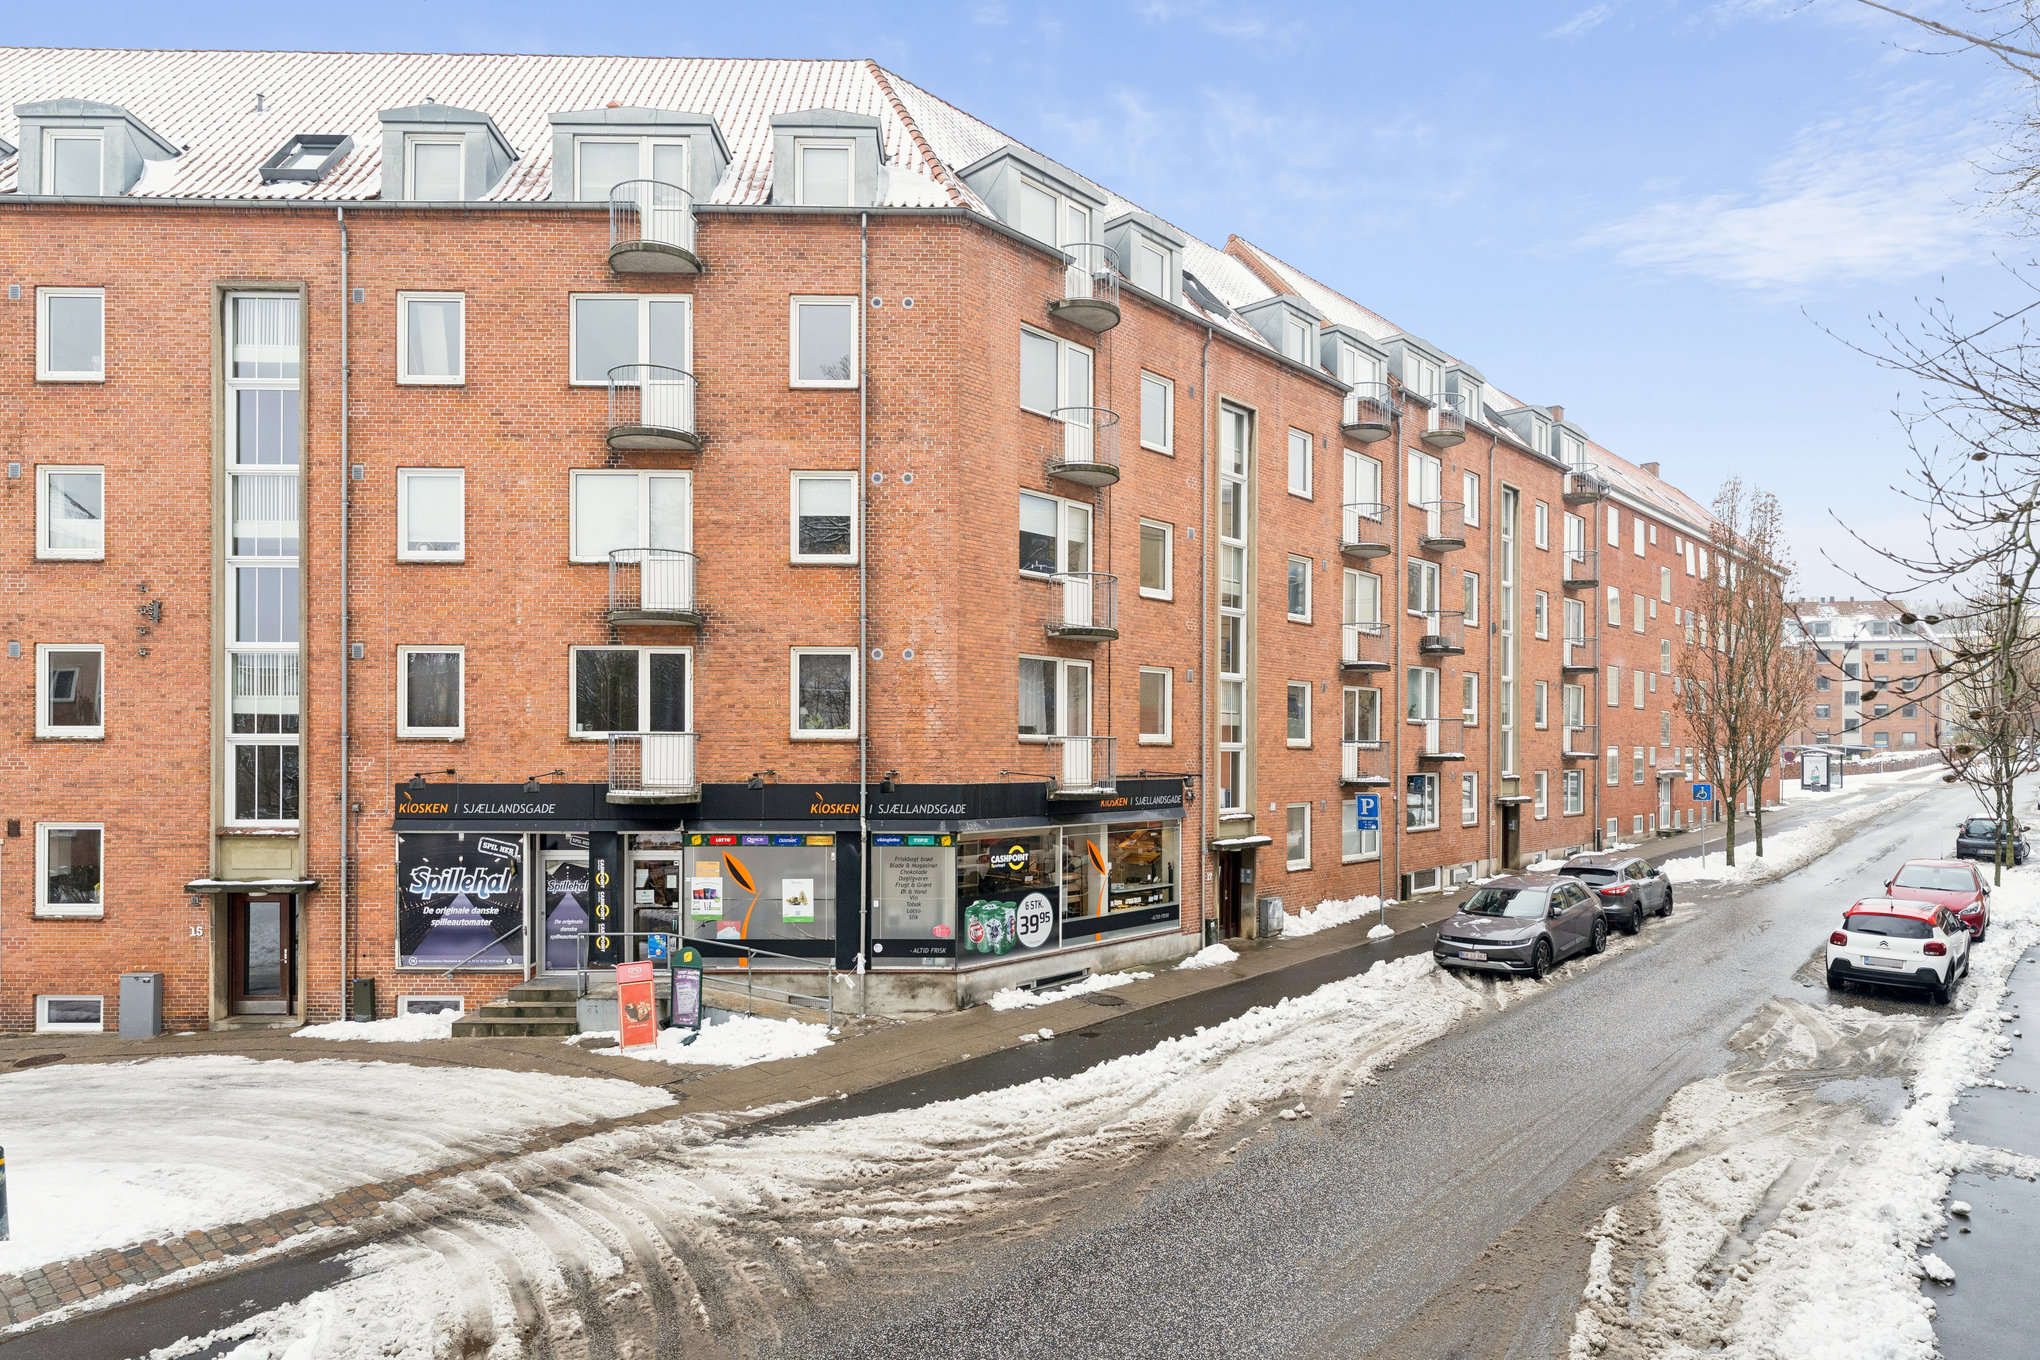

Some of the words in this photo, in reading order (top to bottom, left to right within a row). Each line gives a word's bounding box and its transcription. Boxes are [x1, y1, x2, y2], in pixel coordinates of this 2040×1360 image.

[1100, 797, 1128, 807] KIOSKEN
[1135, 795, 1182, 806] SJÆLLANDSGADE
[1360, 798, 1374, 815] P
[398, 803, 448, 814] KIOSKEN
[463, 803, 556, 814] SJÆLLANDSGADE
[810, 803, 859, 814] KIOSKEN
[878, 803, 967, 814] SJÆLLANDSGADE
[482, 842, 499, 852] SPIL
[499, 845, 515, 855] HER
[991, 853, 1029, 863] CASHPOINT
[409, 866, 513, 900] Spillehal
[547, 880, 590, 894] Spillehal
[423, 907, 434, 915] De
[435, 906, 470, 915] originale
[471, 906, 500, 915] danske
[1025, 901, 1030, 911] 6
[1030, 900, 1044, 910] STK.
[430, 919, 493, 927] spilleautomater
[189, 926, 203, 937] 15
